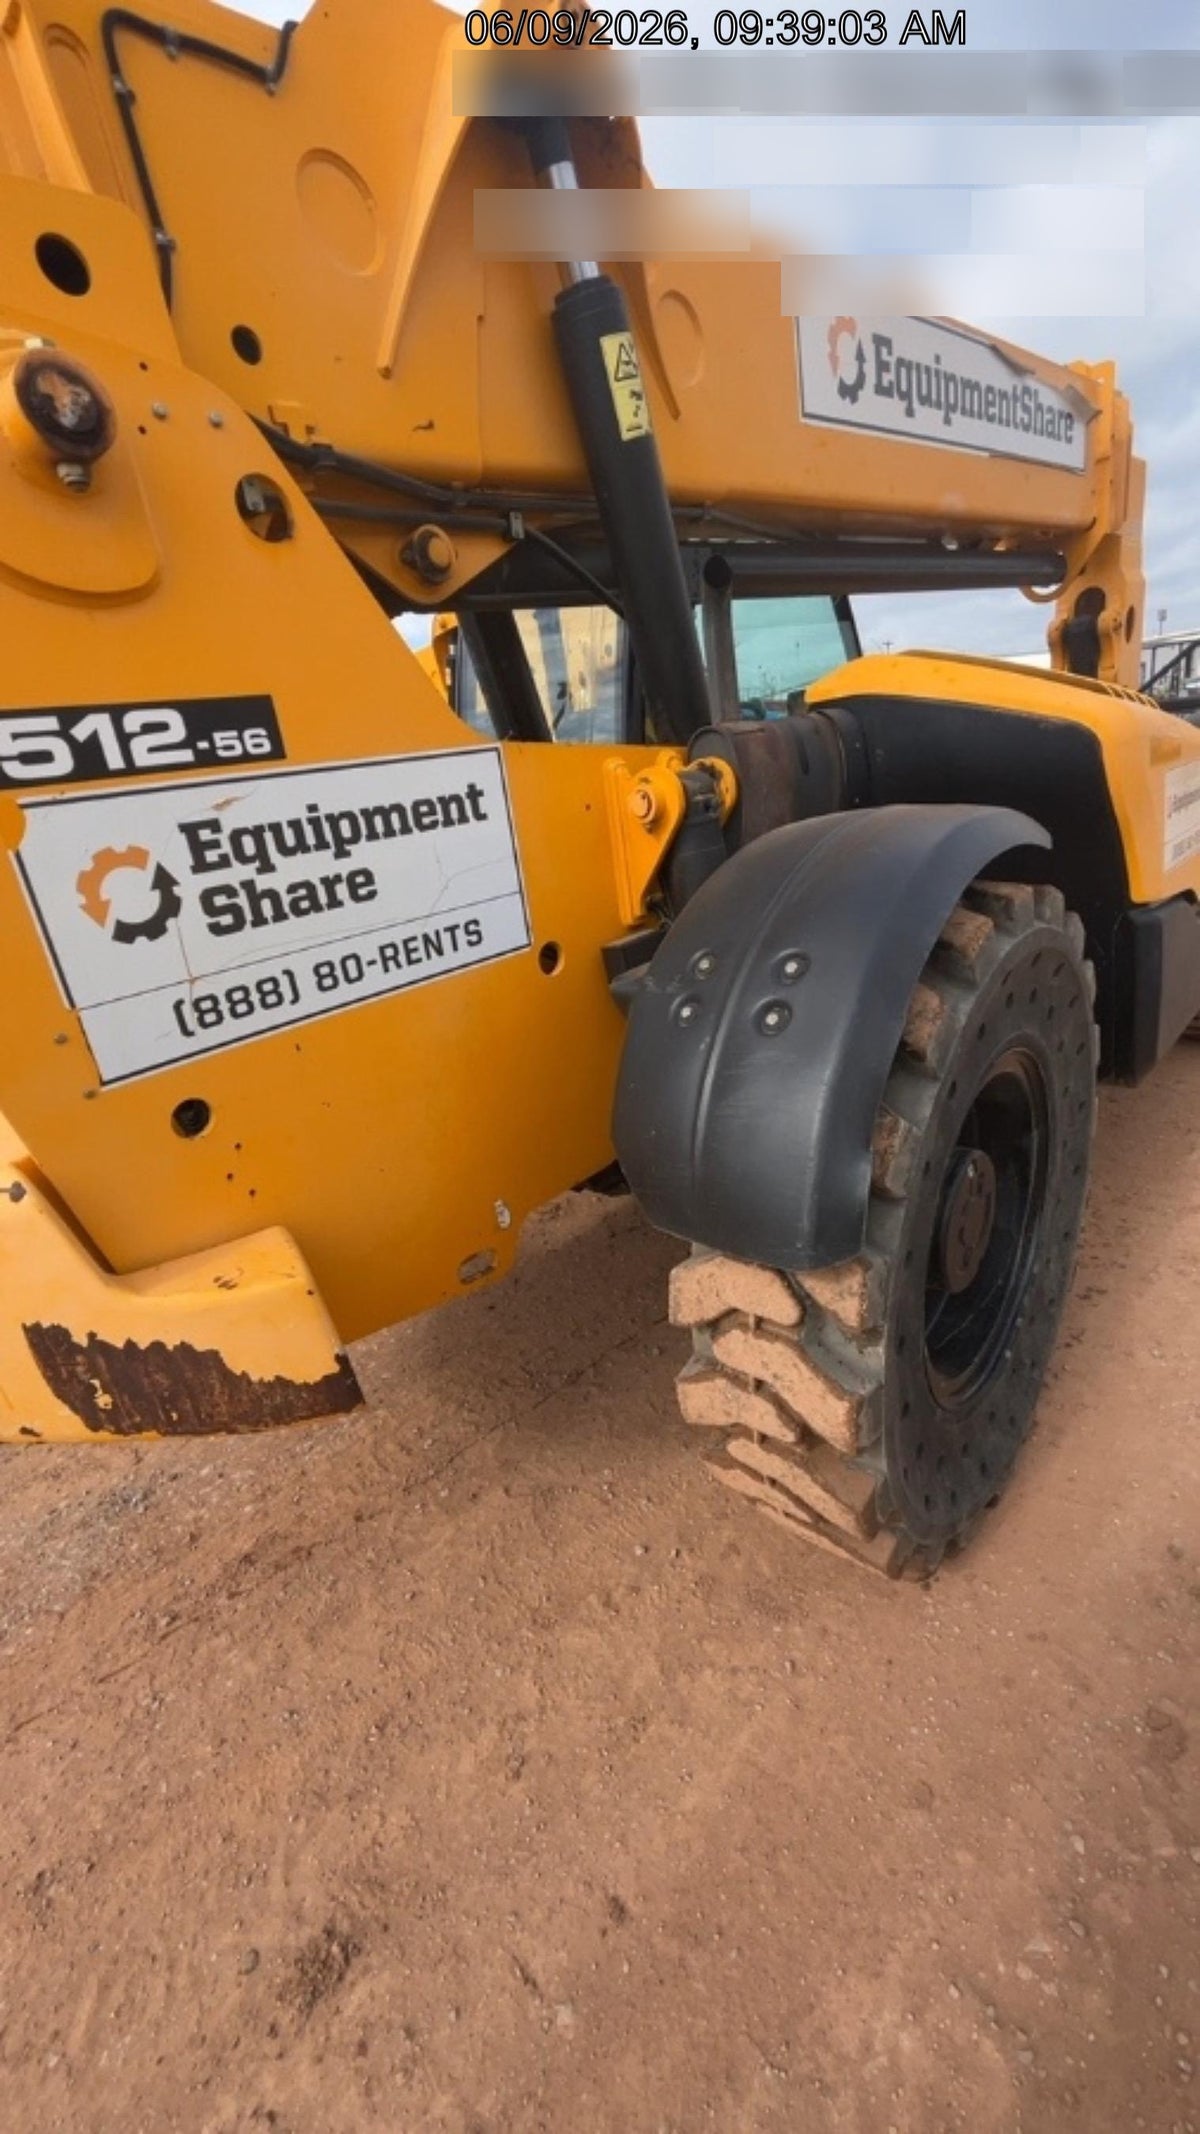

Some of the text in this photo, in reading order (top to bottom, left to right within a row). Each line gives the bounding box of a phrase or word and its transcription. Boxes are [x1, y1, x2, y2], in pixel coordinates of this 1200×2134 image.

[872, 333, 1075, 445] EquipmentShare
[0, 708, 272, 780] 512-56
[178, 783, 488, 875] Equipment
[200, 867, 378, 937] Share
[172, 918, 484, 1037] (888) 80-RENTS
